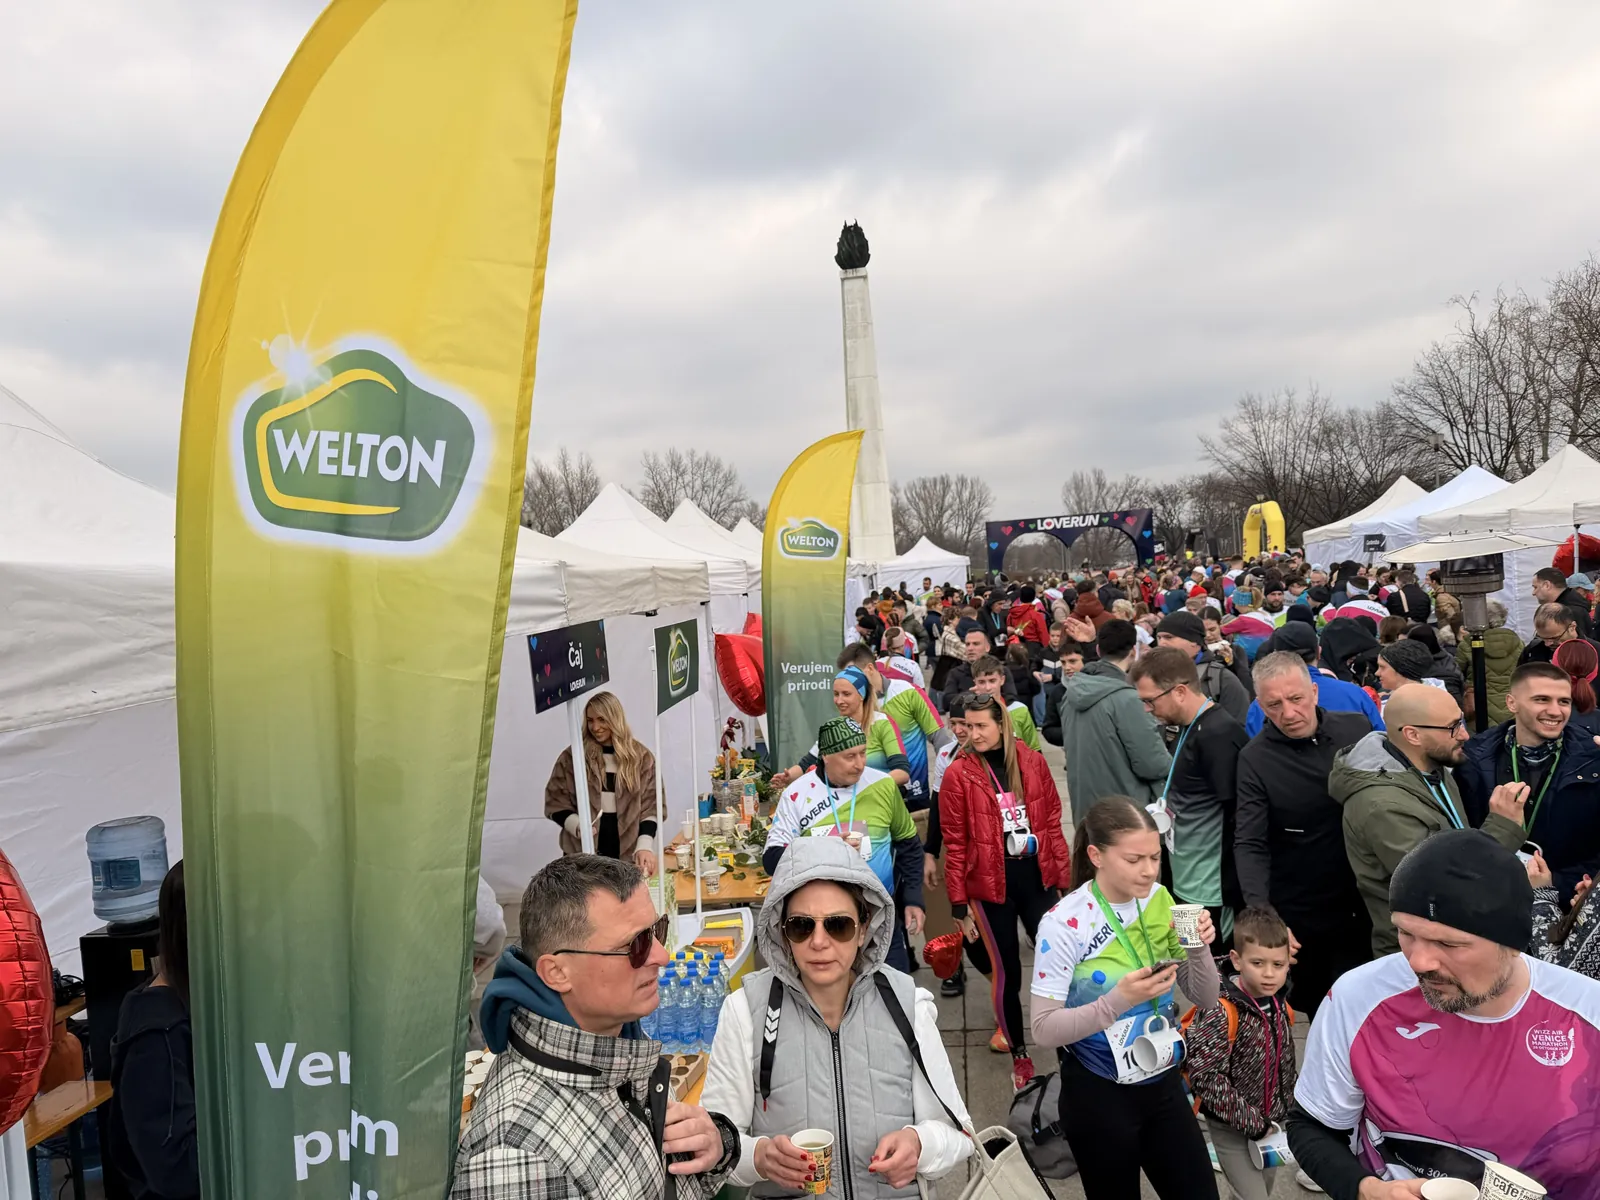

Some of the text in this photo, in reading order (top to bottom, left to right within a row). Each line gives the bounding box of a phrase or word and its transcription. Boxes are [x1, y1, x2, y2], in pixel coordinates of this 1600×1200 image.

[272, 428, 447, 489] WELTON
[1037, 514, 1100, 531] LOVERUN
[787, 534, 835, 548] WELTON
[568, 641, 584, 670] Čaj
[781, 661, 834, 676] Verujem
[787, 678, 831, 694] prirodi
[800, 791, 840, 829] OVERUN
[1531, 1034, 1567, 1042] VENICE
[1531, 1040, 1569, 1048] MARATHON
[1493, 1177, 1520, 1198] cafe
